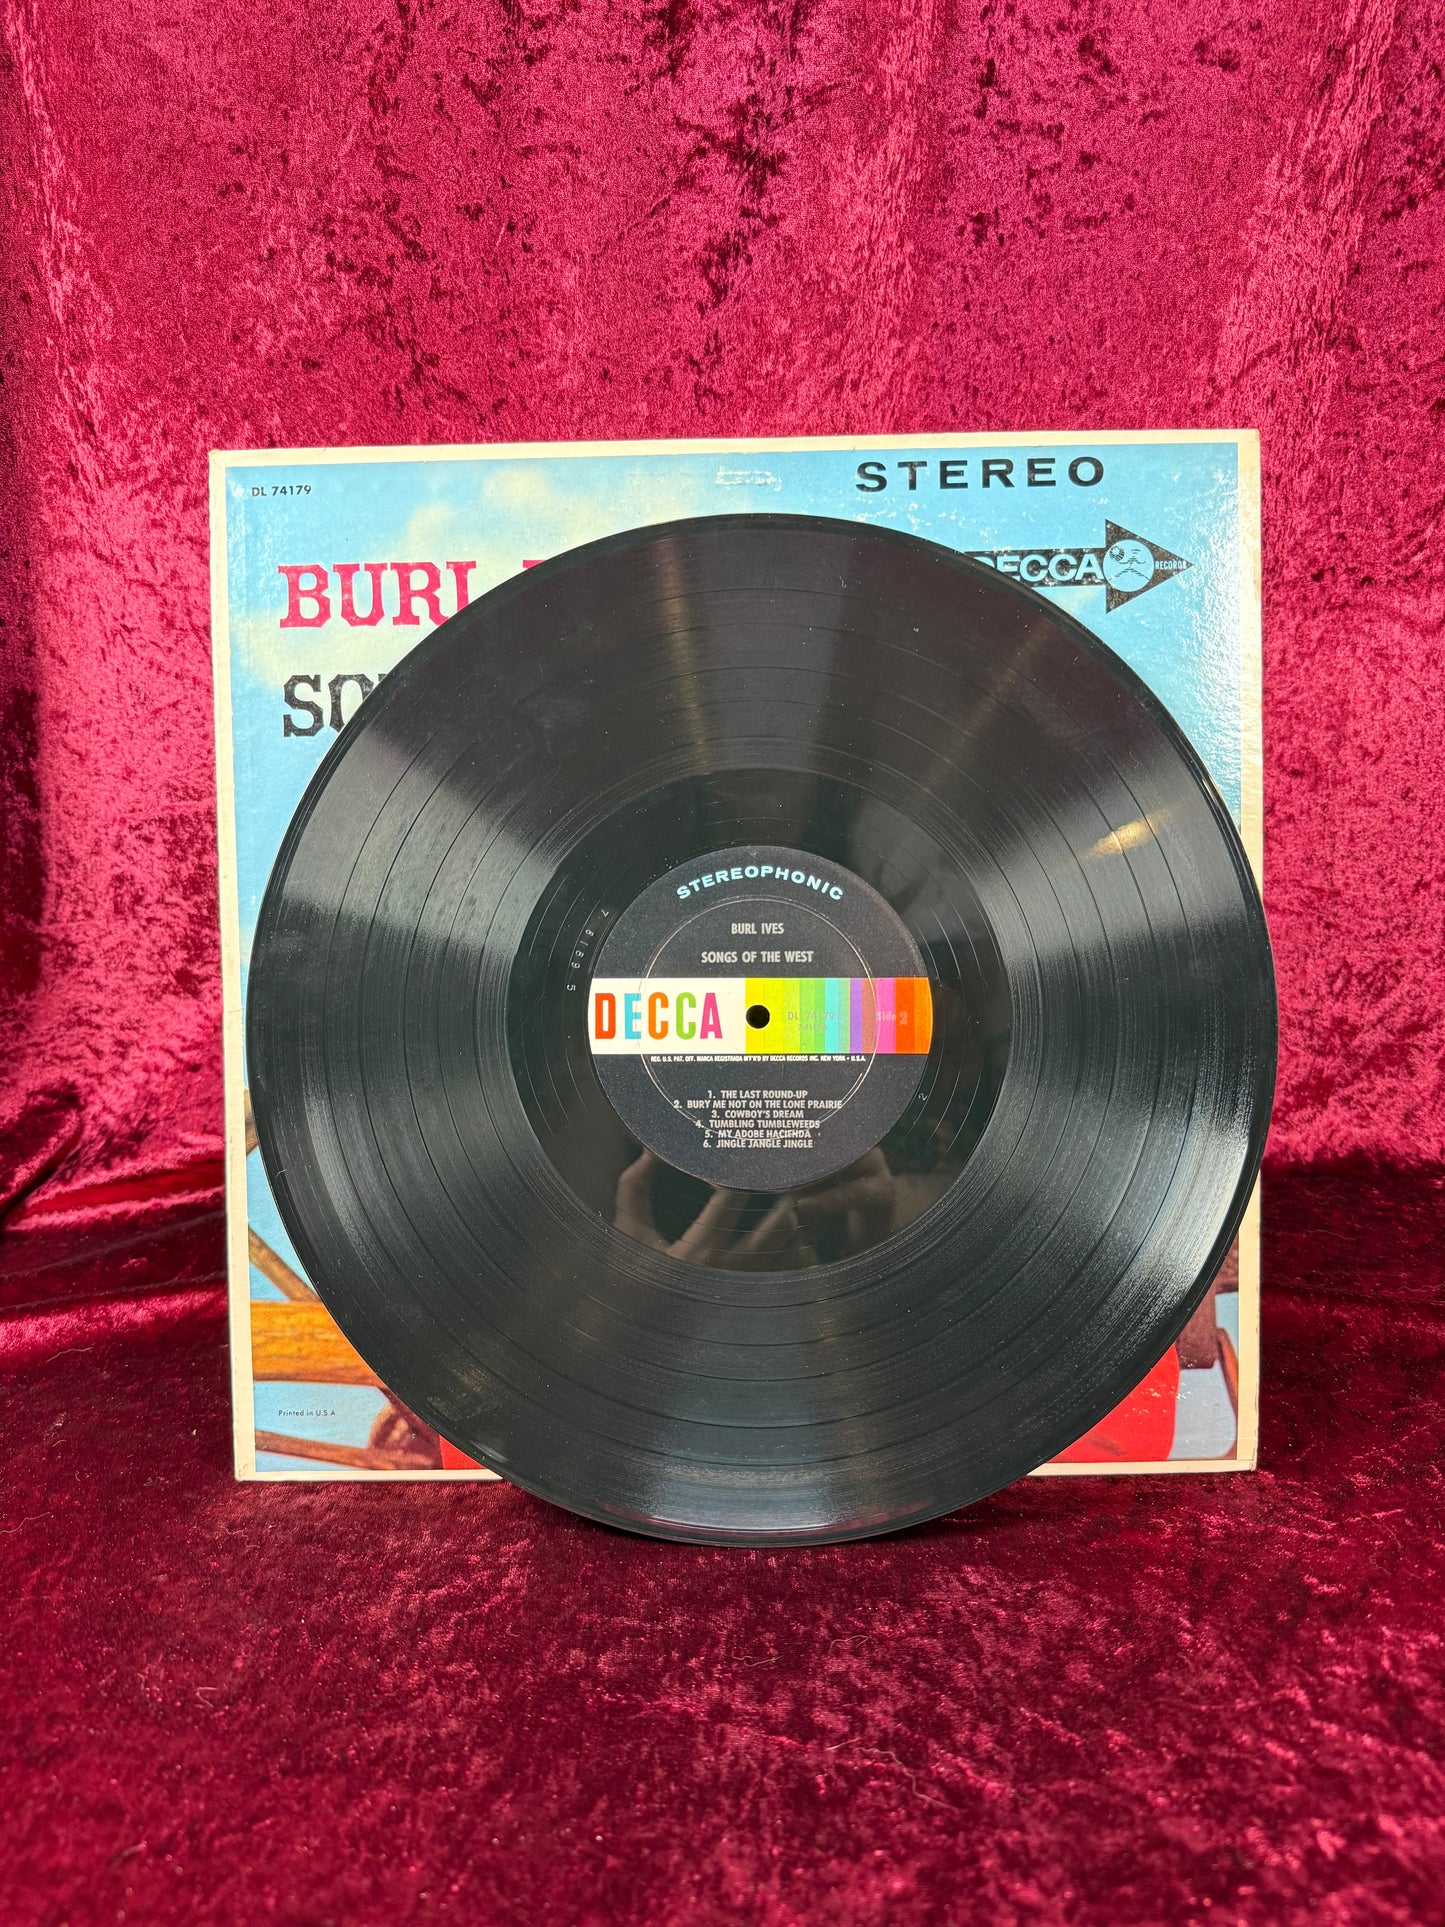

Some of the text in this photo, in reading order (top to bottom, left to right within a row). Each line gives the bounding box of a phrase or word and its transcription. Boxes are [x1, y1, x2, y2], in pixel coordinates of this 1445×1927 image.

[856, 456, 1104, 492] STEREO
[251, 484, 312, 497] DL 74179
[676, 865, 844, 900] STEREOPHONIC
[731, 922, 785, 935] BURL IVES
[701, 951, 814, 963] SONGS OF THE WEST
[594, 991, 723, 1040] DECCA
[899, 1011, 908, 1025] 2
[707, 1090, 808, 1099] 1. THE LAST ROUND-UP
[673, 1100, 842, 1109] 2. BURY ME NOT ON THE LONE PRAIRIE
[711, 1110, 804, 1119] 3. COWBOY'S DREAM
[695, 1120, 820, 1129] 4. TUMBLING TUMBLEWEEDS
[705, 1129, 811, 1138] 5. MY ADOBE HACIENDA
[703, 1139, 813, 1148] 6. JINGLE JANGLE JINGLE
[278, 1409, 304, 1417] Printed
[306, 1409, 313, 1417] in
